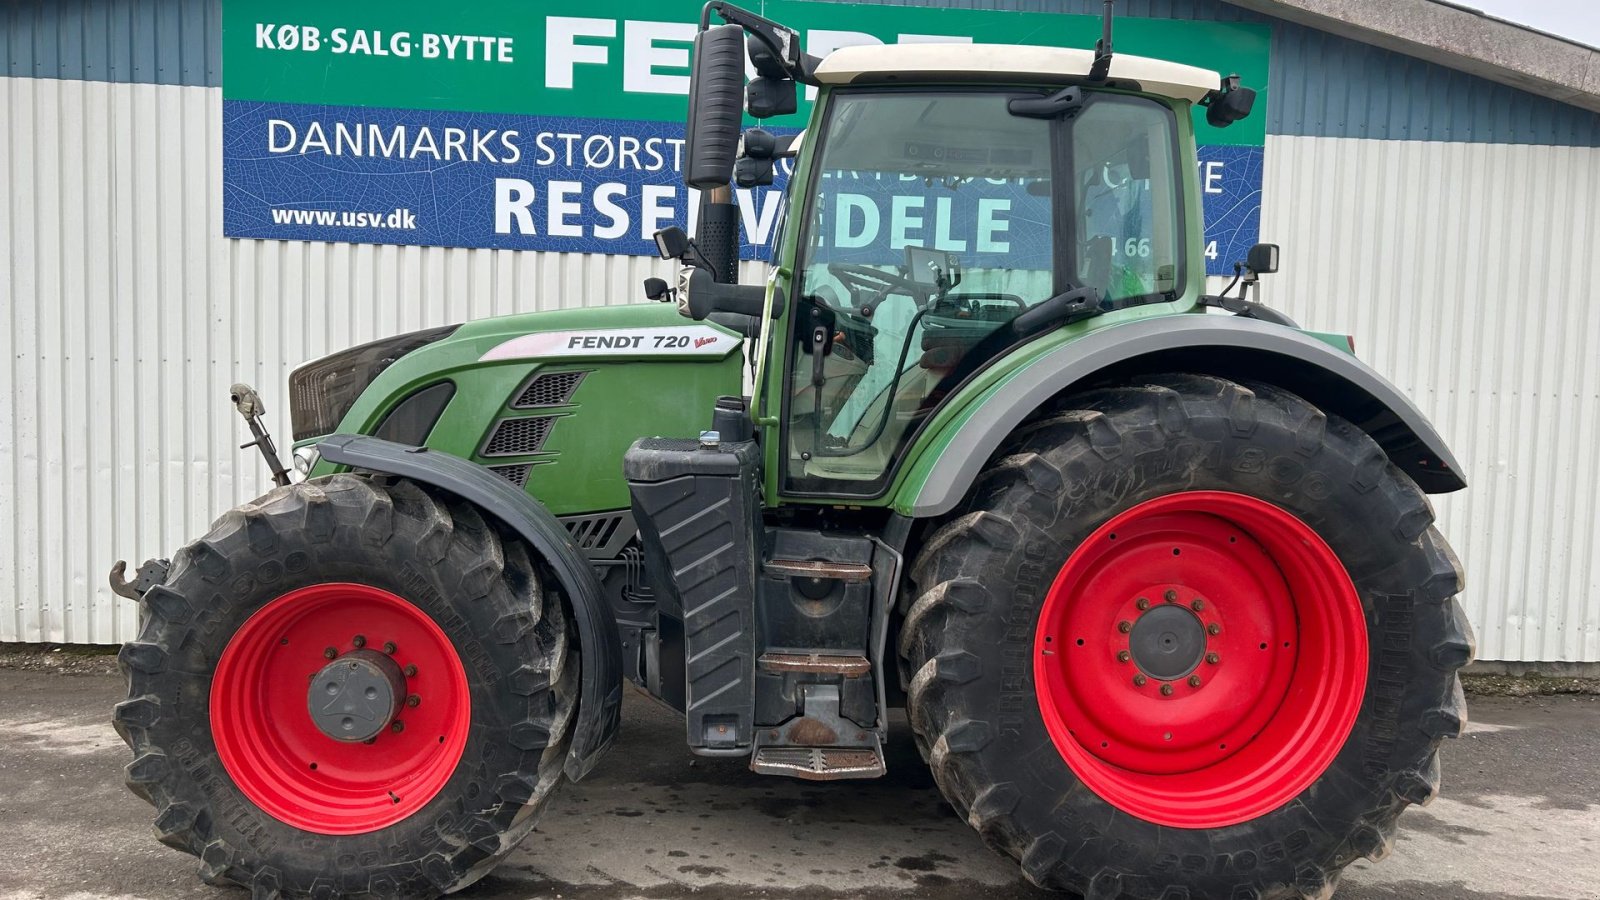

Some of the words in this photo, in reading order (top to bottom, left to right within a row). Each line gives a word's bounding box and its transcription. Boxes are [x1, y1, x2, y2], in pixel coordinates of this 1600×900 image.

[267, 119, 521, 164] DANMARKS
[535, 131, 687, 172] STØRST
[271, 208, 417, 230] www.usv.dk
[494, 178, 1012, 254] RESEVDELE
[1124, 237, 1150, 258] 66
[567, 335, 645, 349] FENDT
[653, 335, 690, 348] 720
